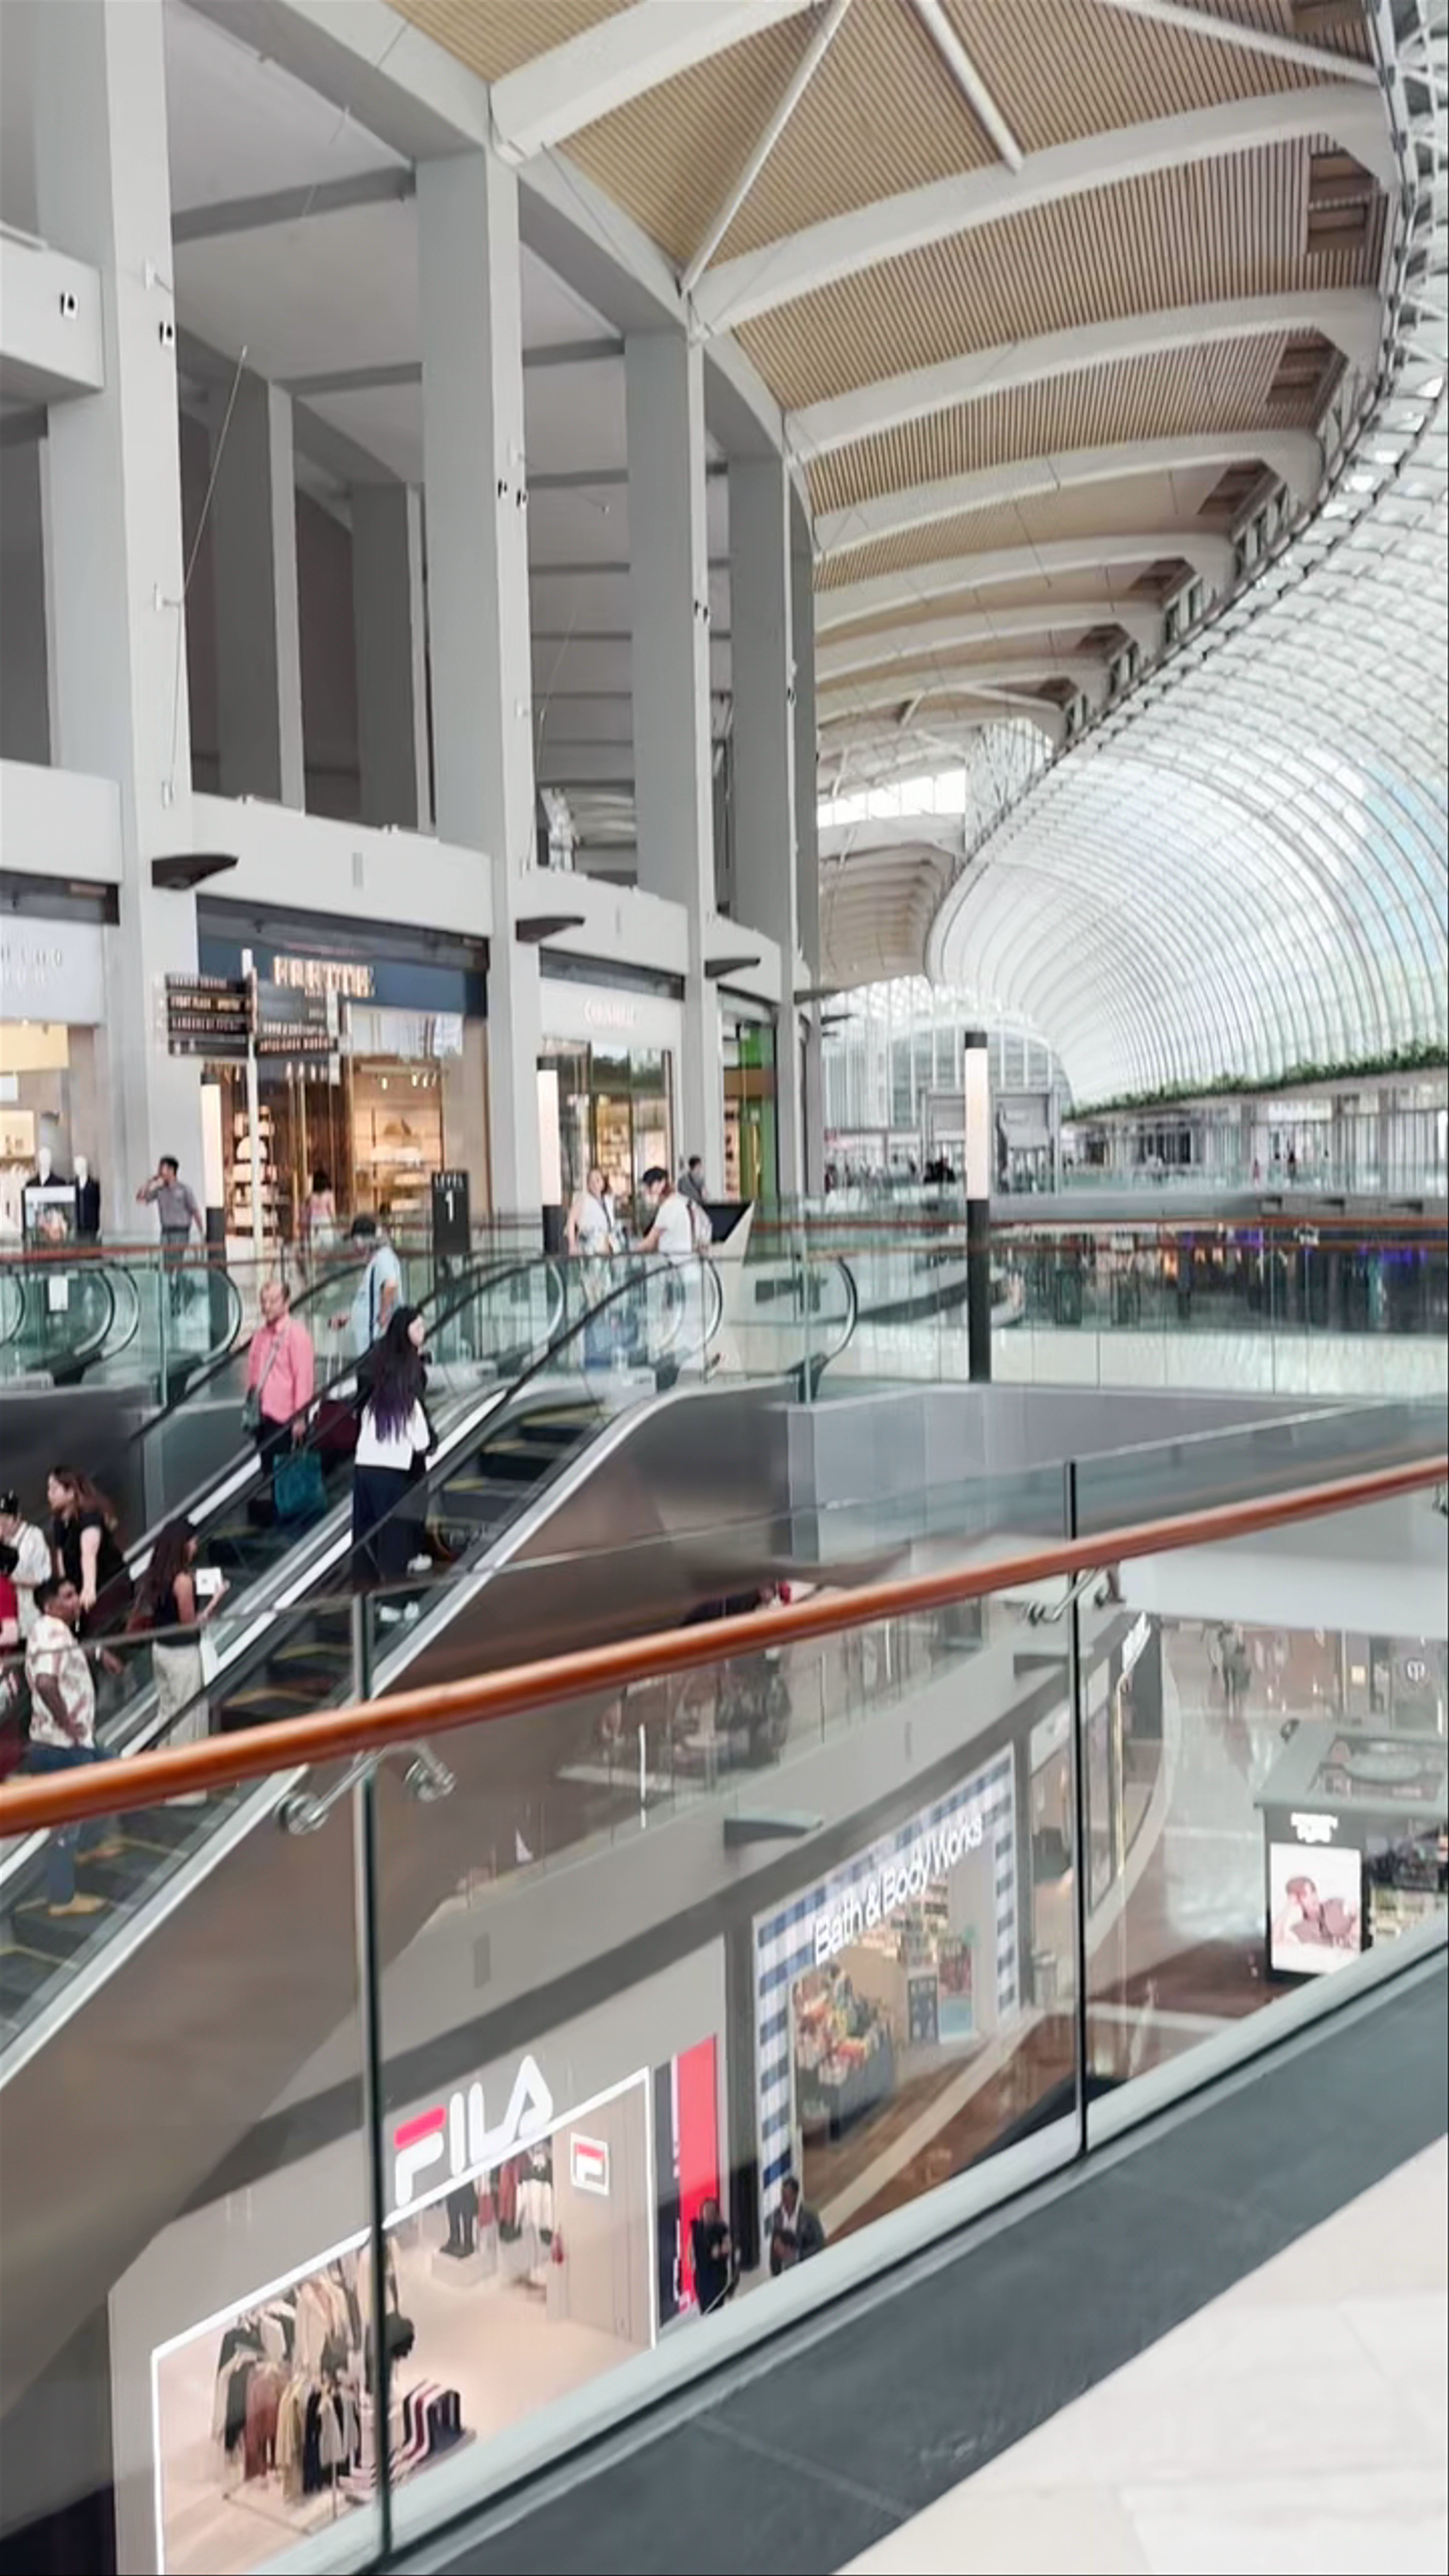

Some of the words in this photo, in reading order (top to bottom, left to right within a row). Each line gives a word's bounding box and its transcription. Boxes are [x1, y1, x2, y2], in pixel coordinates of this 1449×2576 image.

[445, 1189, 454, 1221] 1
[815, 1899, 863, 1965] Bath
[865, 1882, 881, 1927] &
[883, 1847, 931, 1915] Body
[931, 1816, 982, 1875] Works
[394, 2055, 554, 2208] FILA
